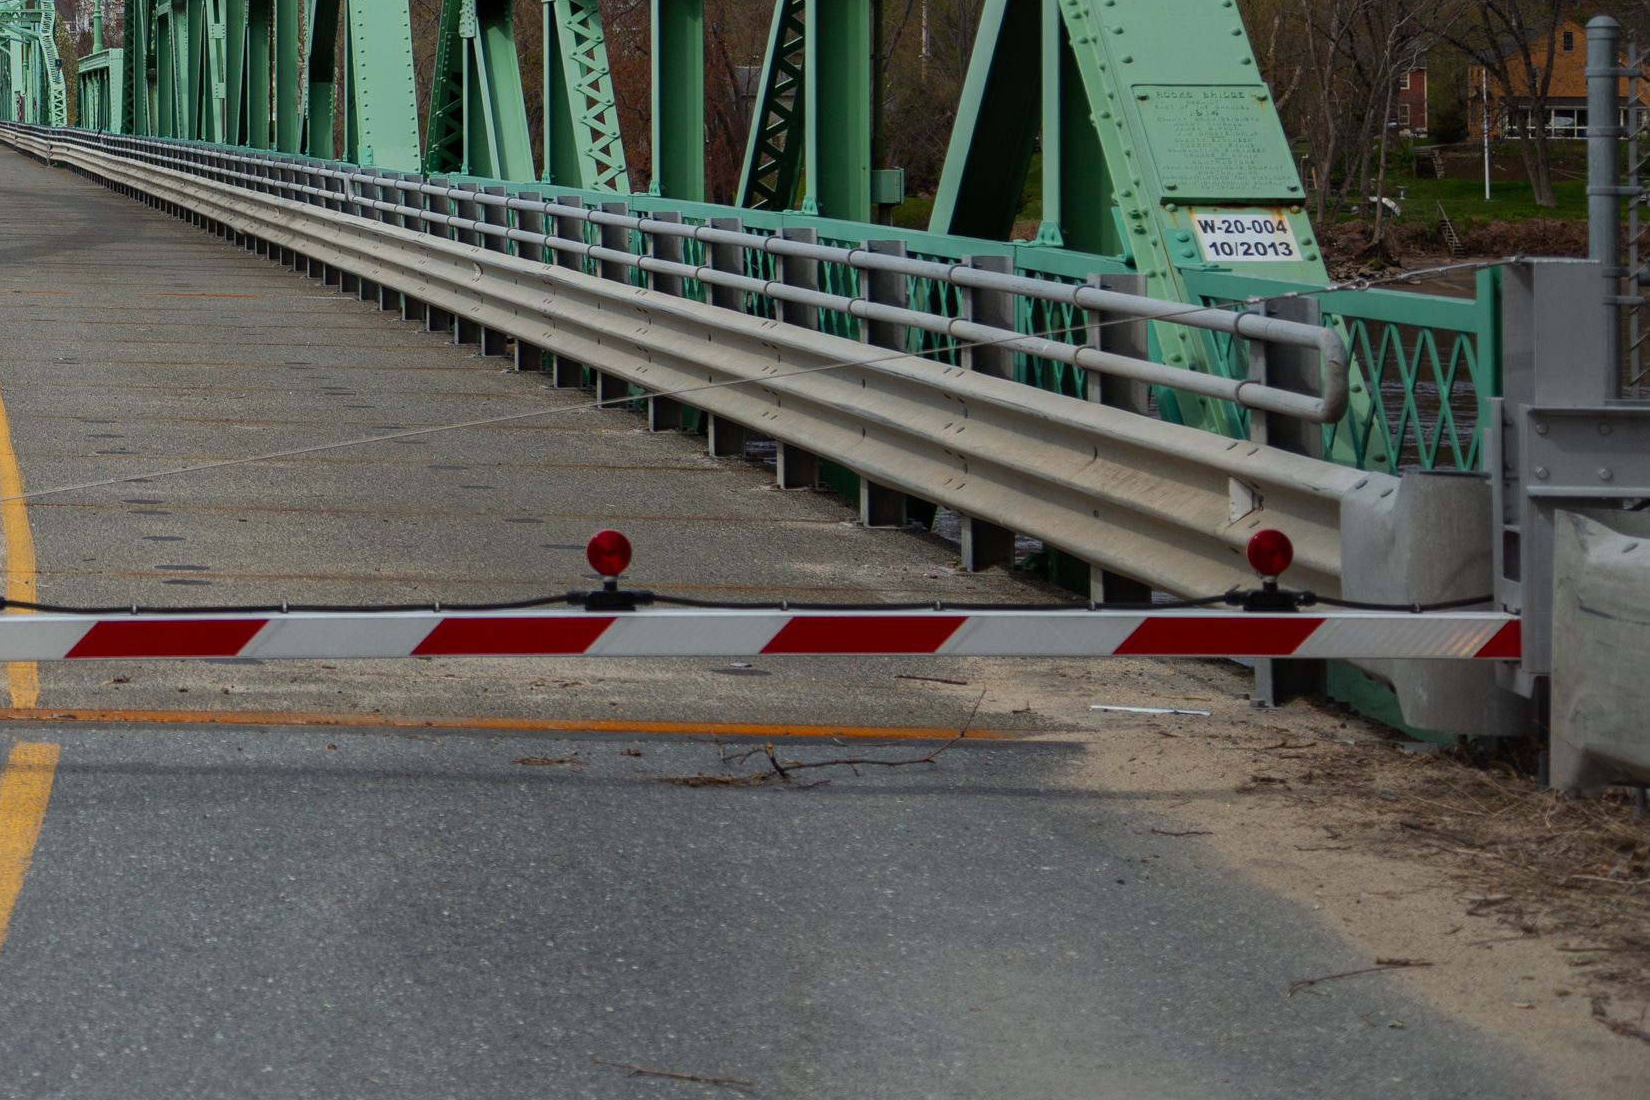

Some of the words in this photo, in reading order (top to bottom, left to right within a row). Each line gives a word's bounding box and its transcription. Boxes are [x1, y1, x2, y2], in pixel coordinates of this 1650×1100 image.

[1156, 91, 1193, 99] ROCKS
[1203, 91, 1245, 99] BRIDGE
[1198, 219, 1288, 234] W-20-004
[1209, 241, 1294, 257] 10/2013
